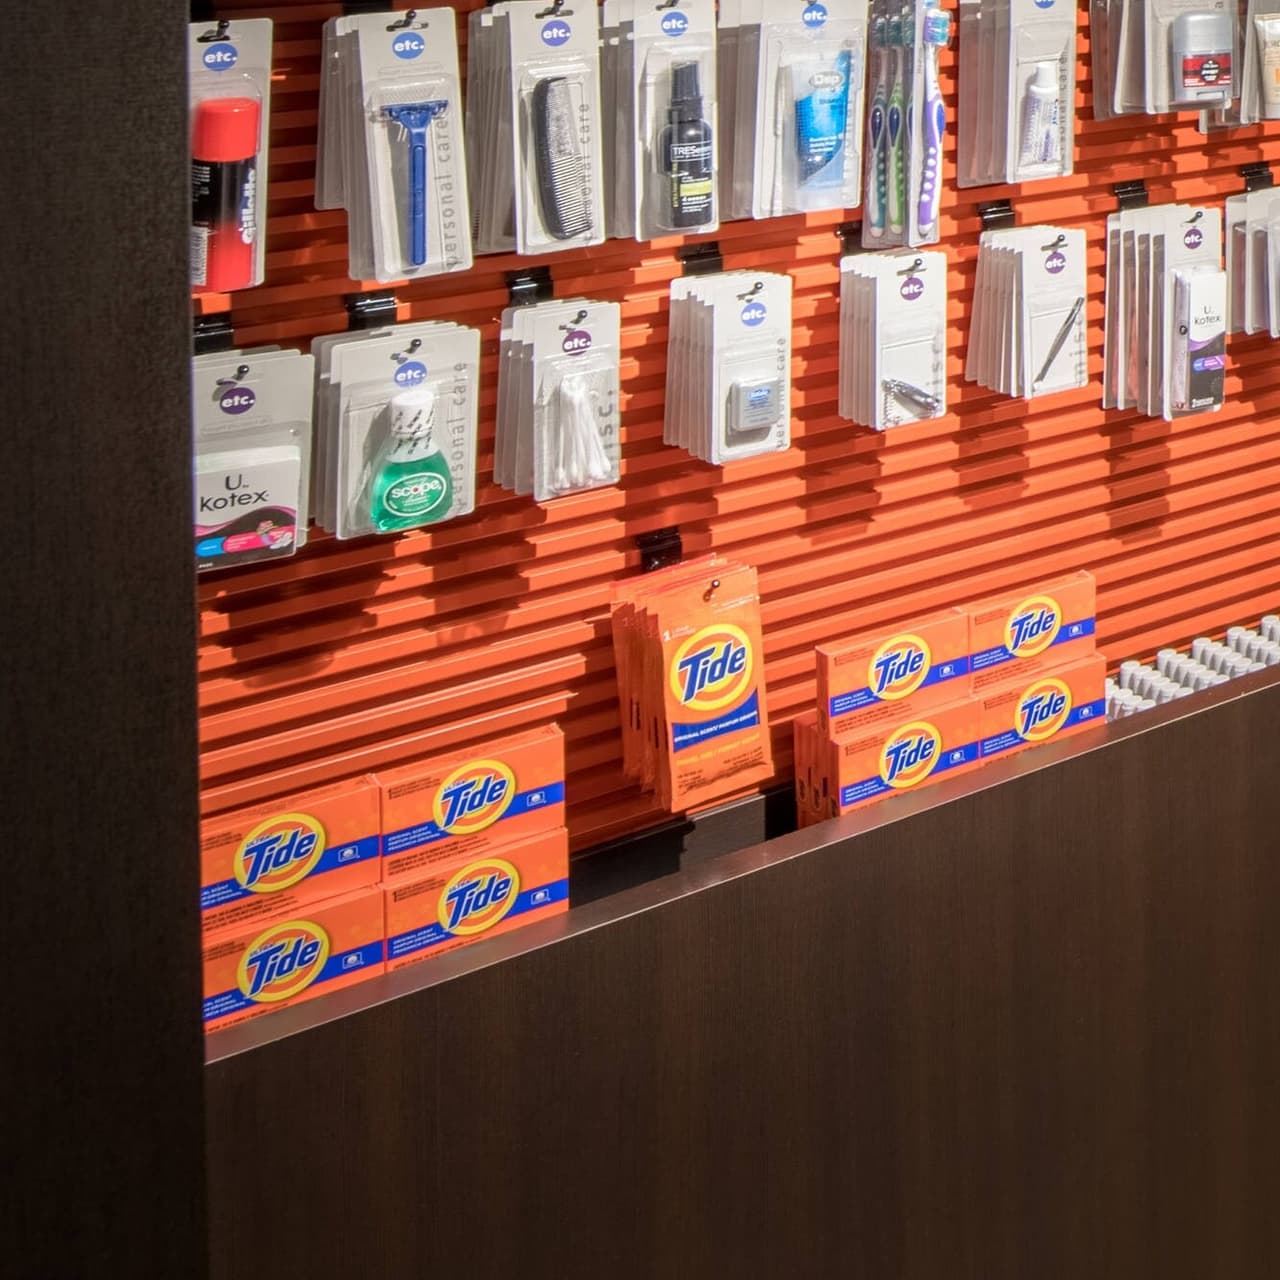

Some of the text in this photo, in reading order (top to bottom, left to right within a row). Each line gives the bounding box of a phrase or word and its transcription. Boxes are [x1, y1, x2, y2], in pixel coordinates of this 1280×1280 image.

[804, 11, 827, 21] etc.
[663, 20, 688, 29] etc.
[543, 28, 570, 38] etc.
[395, 42, 424, 52] etc.
[205, 52, 237, 63] etc.
[438, 118, 450, 163] care
[1184, 234, 1203, 243] etc.
[1045, 258, 1066, 268] etc.
[902, 285, 924, 295] etc.
[742, 310, 766, 320] etc.
[564, 339, 591, 350] etc.
[396, 369, 425, 380] etc.
[222, 396, 254, 407] etc.
[225, 474, 242, 490] U
[1008, 610, 1055, 653] Tide
[678, 640, 746, 705] Tide
[874, 647, 924, 696] Tide
[1019, 692, 1066, 738] Tide
[882, 734, 935, 784] Tide
[440, 774, 507, 830] Tide
[241, 827, 317, 889] Tide
[445, 873, 513, 931] Tide
[246, 934, 321, 998] Tide
